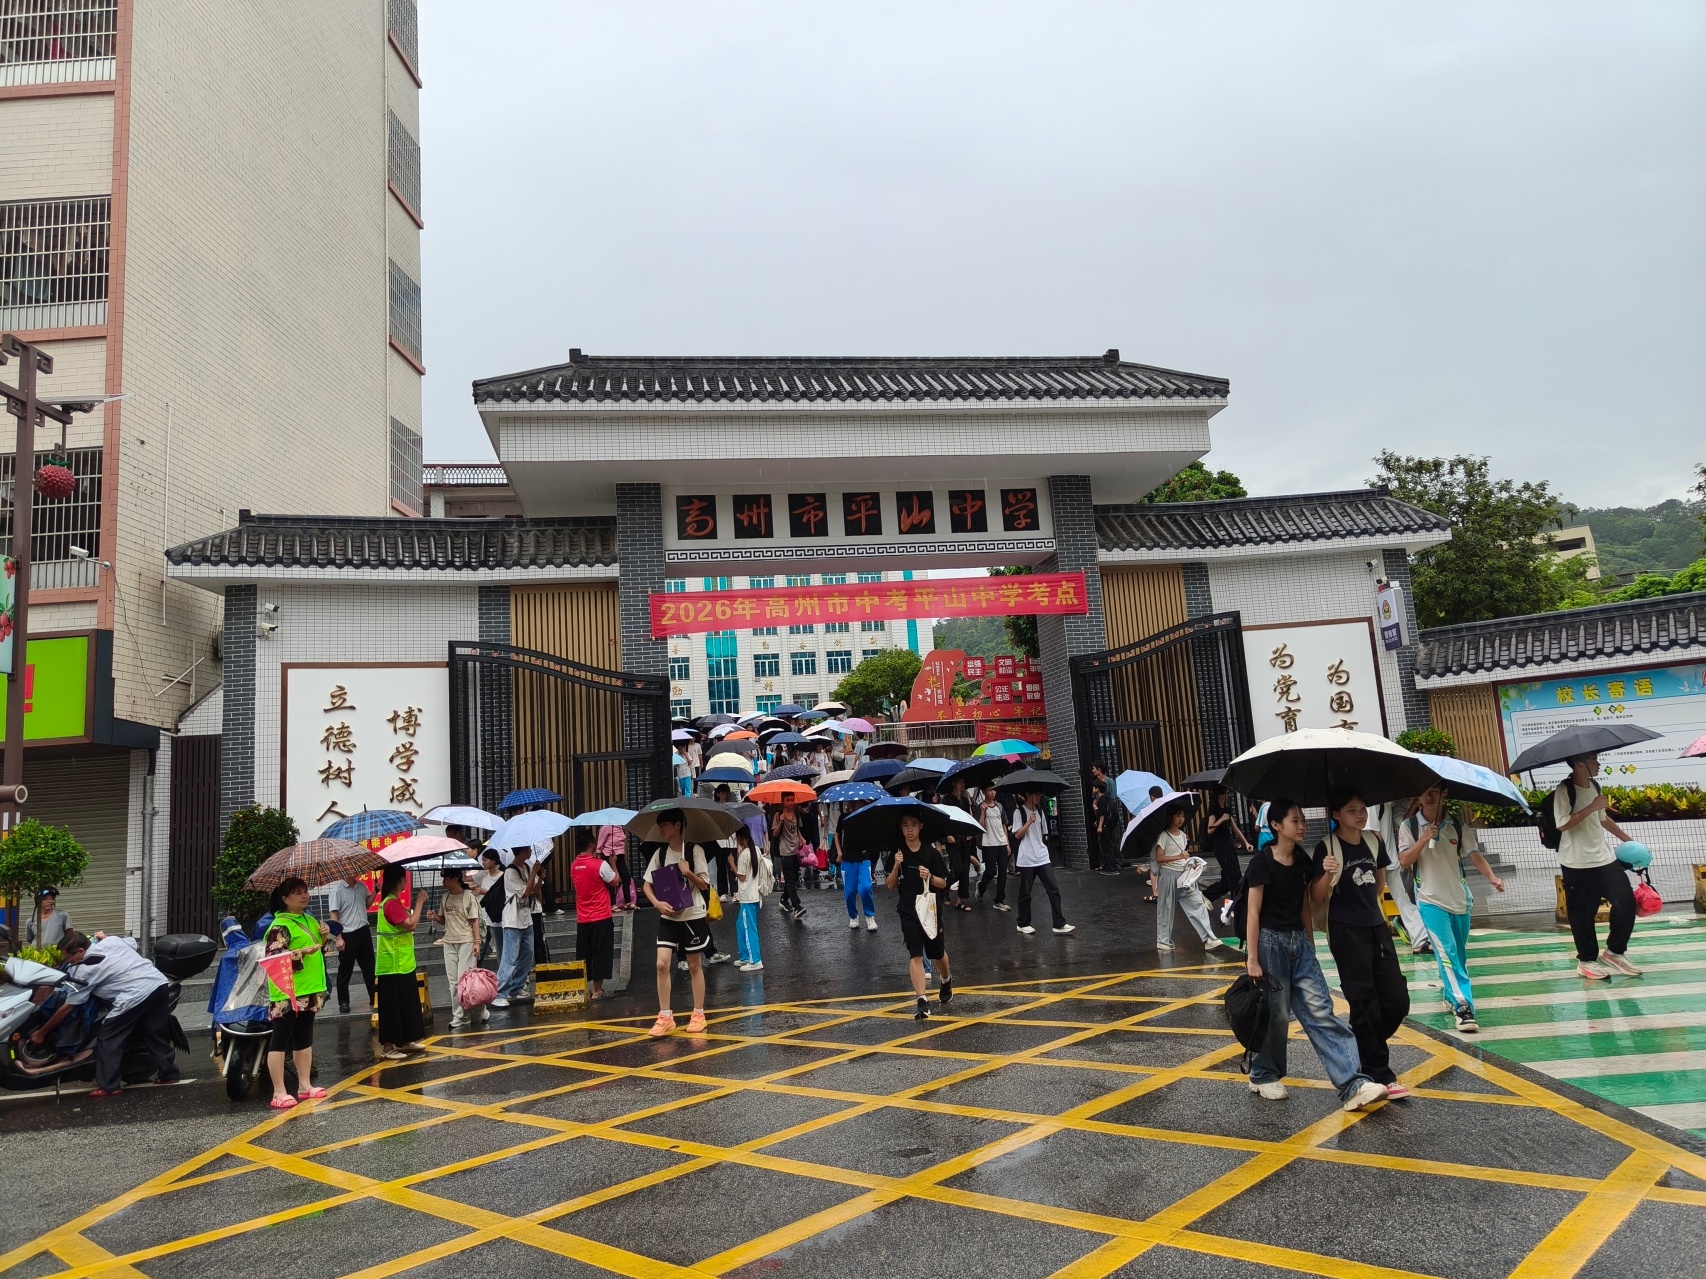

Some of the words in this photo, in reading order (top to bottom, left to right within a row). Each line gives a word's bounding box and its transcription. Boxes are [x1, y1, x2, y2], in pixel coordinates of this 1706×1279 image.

[679, 491, 1038, 537] 高州市平山中学
[660, 579, 1079, 625] 2026年高州市中考平山中学考点
[1269, 642, 1302, 734] 为党育
[1556, 677, 1654, 705] 校长寄语
[936, 708, 1001, 720] 不忘初心
[316, 684, 357, 823] 立德树人
[386, 705, 423, 821] 博学成
